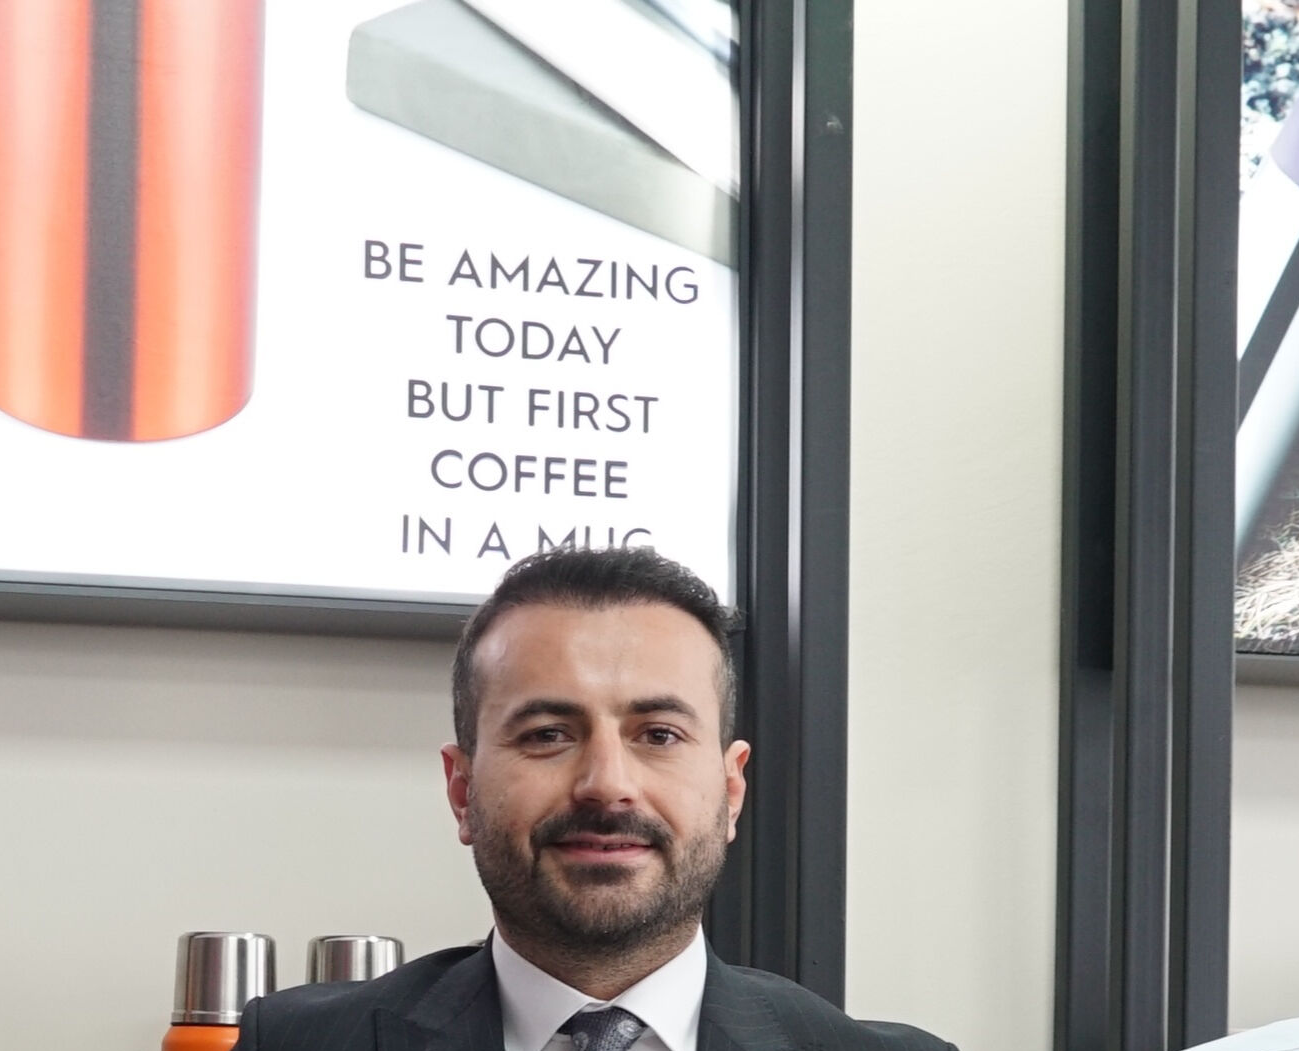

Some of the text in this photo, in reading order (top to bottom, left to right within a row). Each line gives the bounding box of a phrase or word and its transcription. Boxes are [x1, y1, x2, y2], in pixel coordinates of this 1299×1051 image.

[364, 239, 699, 305] BE AMAZING
[446, 314, 622, 365] TODAY
[407, 379, 659, 434] BUT FIRST
[431, 449, 628, 499] COFFEE
[401, 514, 452, 556] IN
[476, 521, 511, 561] A
